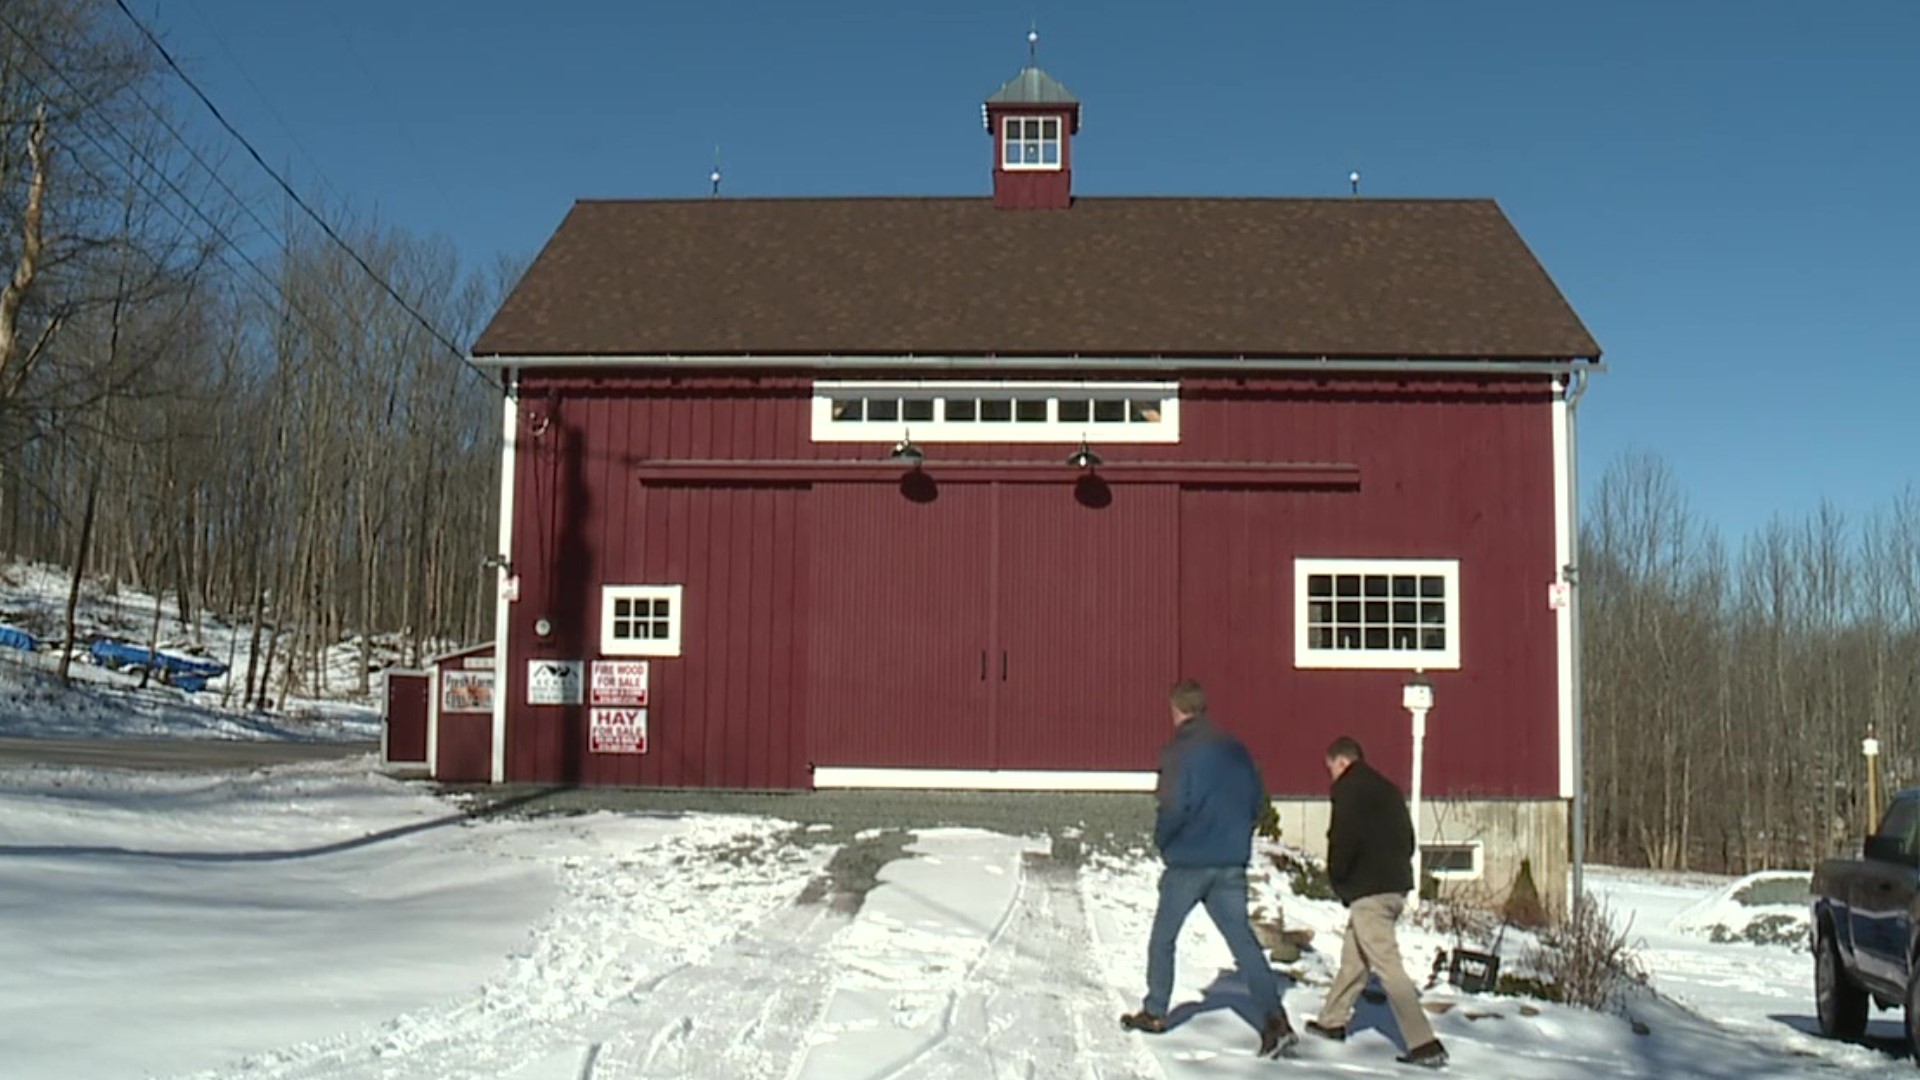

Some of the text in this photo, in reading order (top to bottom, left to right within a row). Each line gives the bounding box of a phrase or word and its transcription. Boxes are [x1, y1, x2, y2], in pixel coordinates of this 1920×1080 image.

[595, 665, 644, 674] FIRE WOOD
[598, 677, 640, 687] FOR SALE
[598, 711, 638, 725] HAY
[593, 726, 642, 737] FOR SALE
